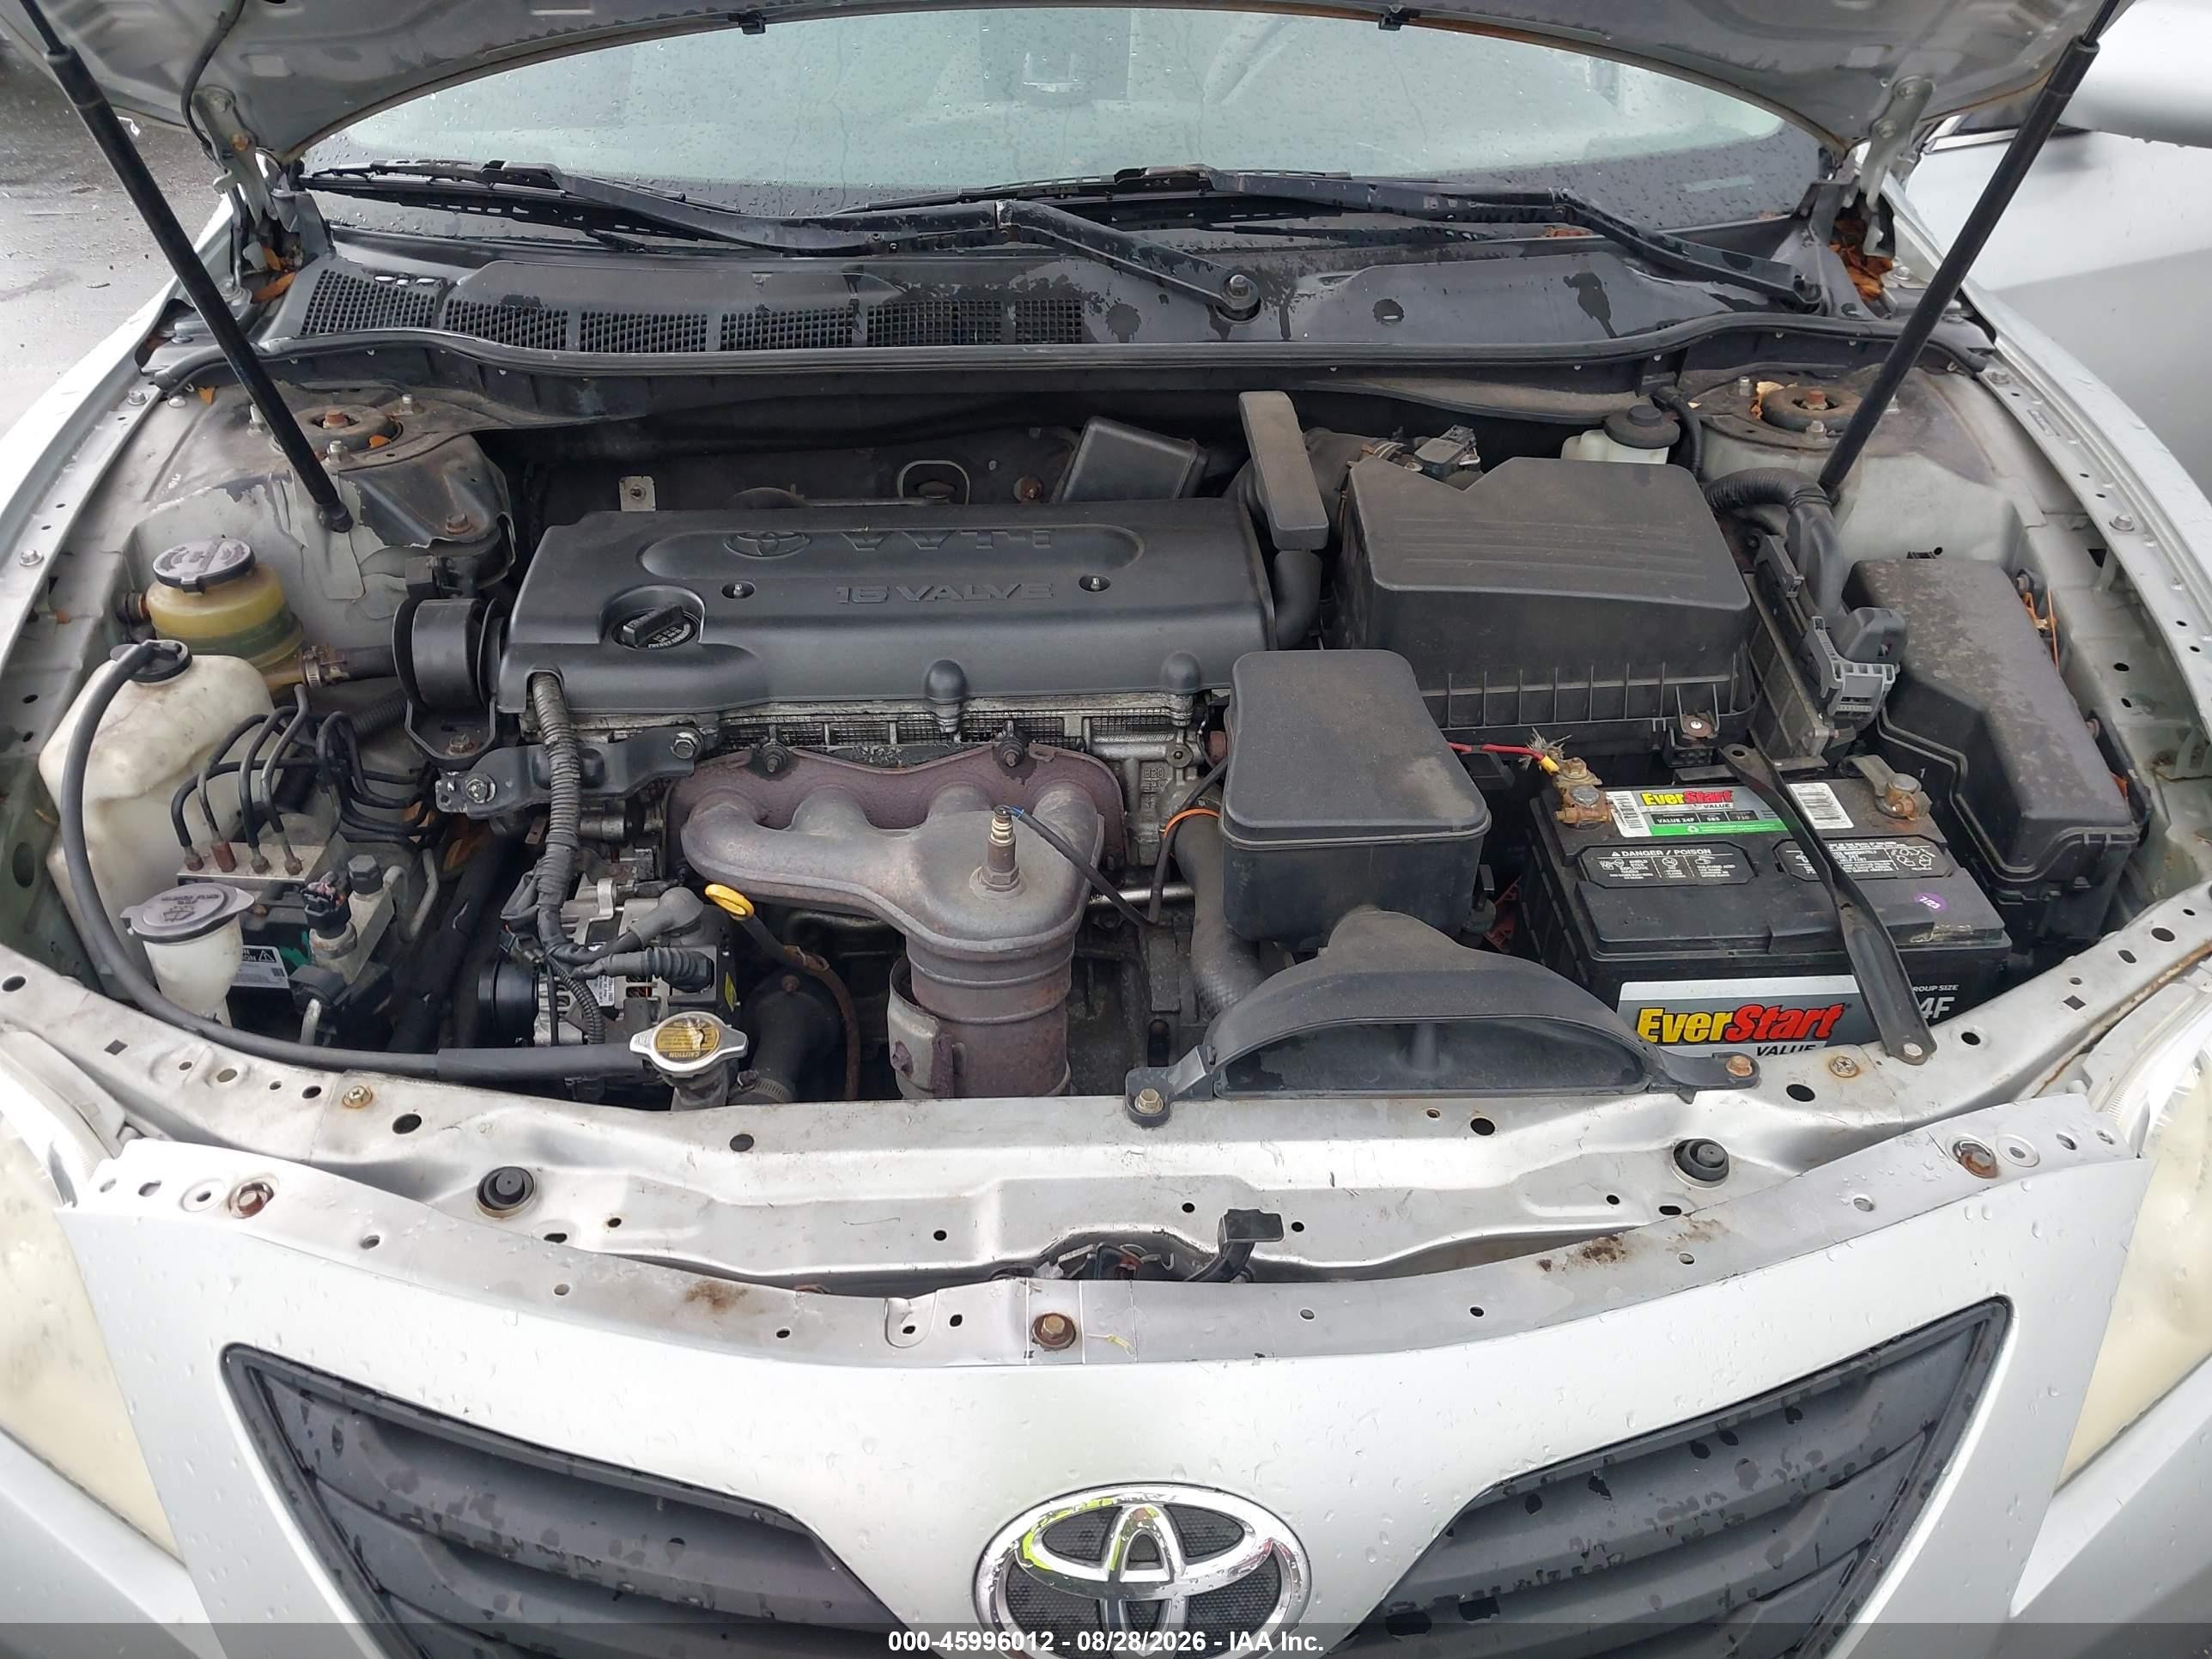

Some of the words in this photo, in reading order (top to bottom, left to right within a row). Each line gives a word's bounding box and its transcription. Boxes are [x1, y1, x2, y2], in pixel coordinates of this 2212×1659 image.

[836, 586, 890, 605] 16
[896, 583, 1055, 602] VALVE
[1641, 789, 1733, 807] EverStart
[1919, 996, 1955, 1019] 4F
[1637, 1003, 1845, 1044] EverStart
